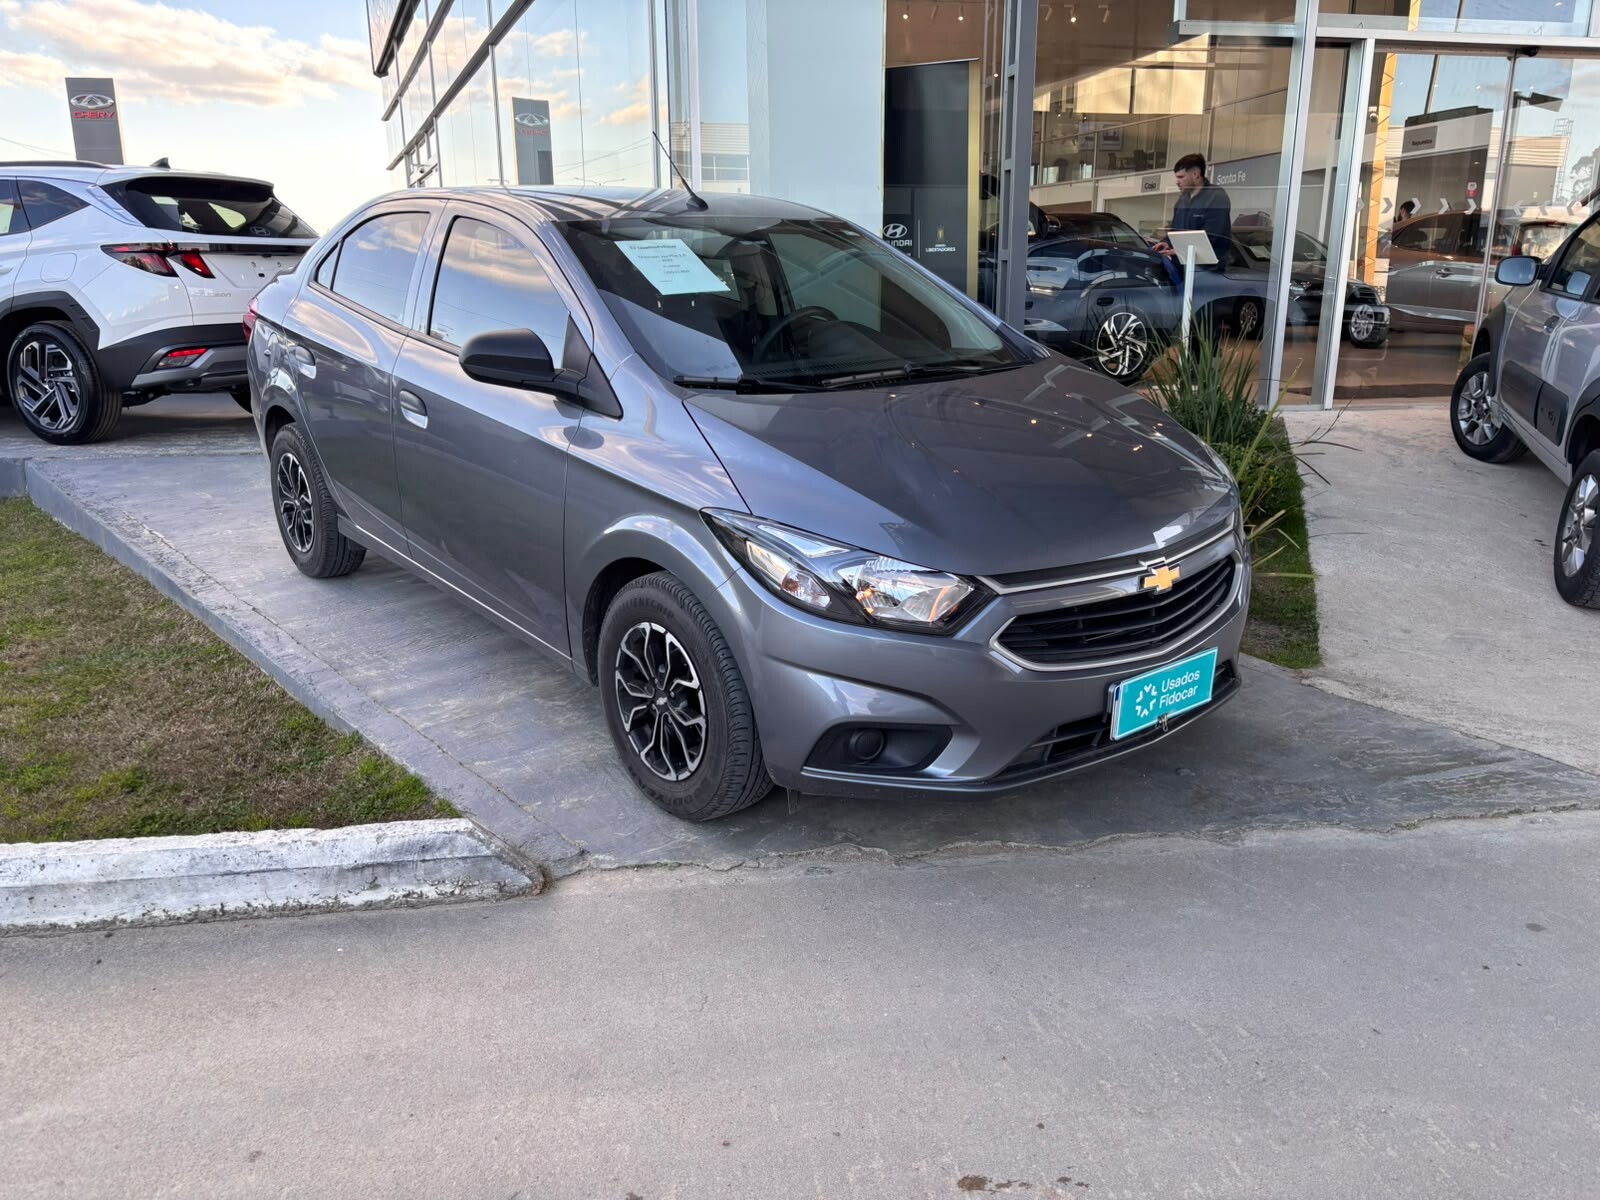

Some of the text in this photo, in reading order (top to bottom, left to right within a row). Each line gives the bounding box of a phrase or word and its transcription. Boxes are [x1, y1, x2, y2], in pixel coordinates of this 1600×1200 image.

[73, 111, 116, 119] CHERY
[1216, 170, 1247, 185] Santa Fe
[1161, 669, 1200, 693] Usados
[1159, 685, 1198, 709] Fidocar
